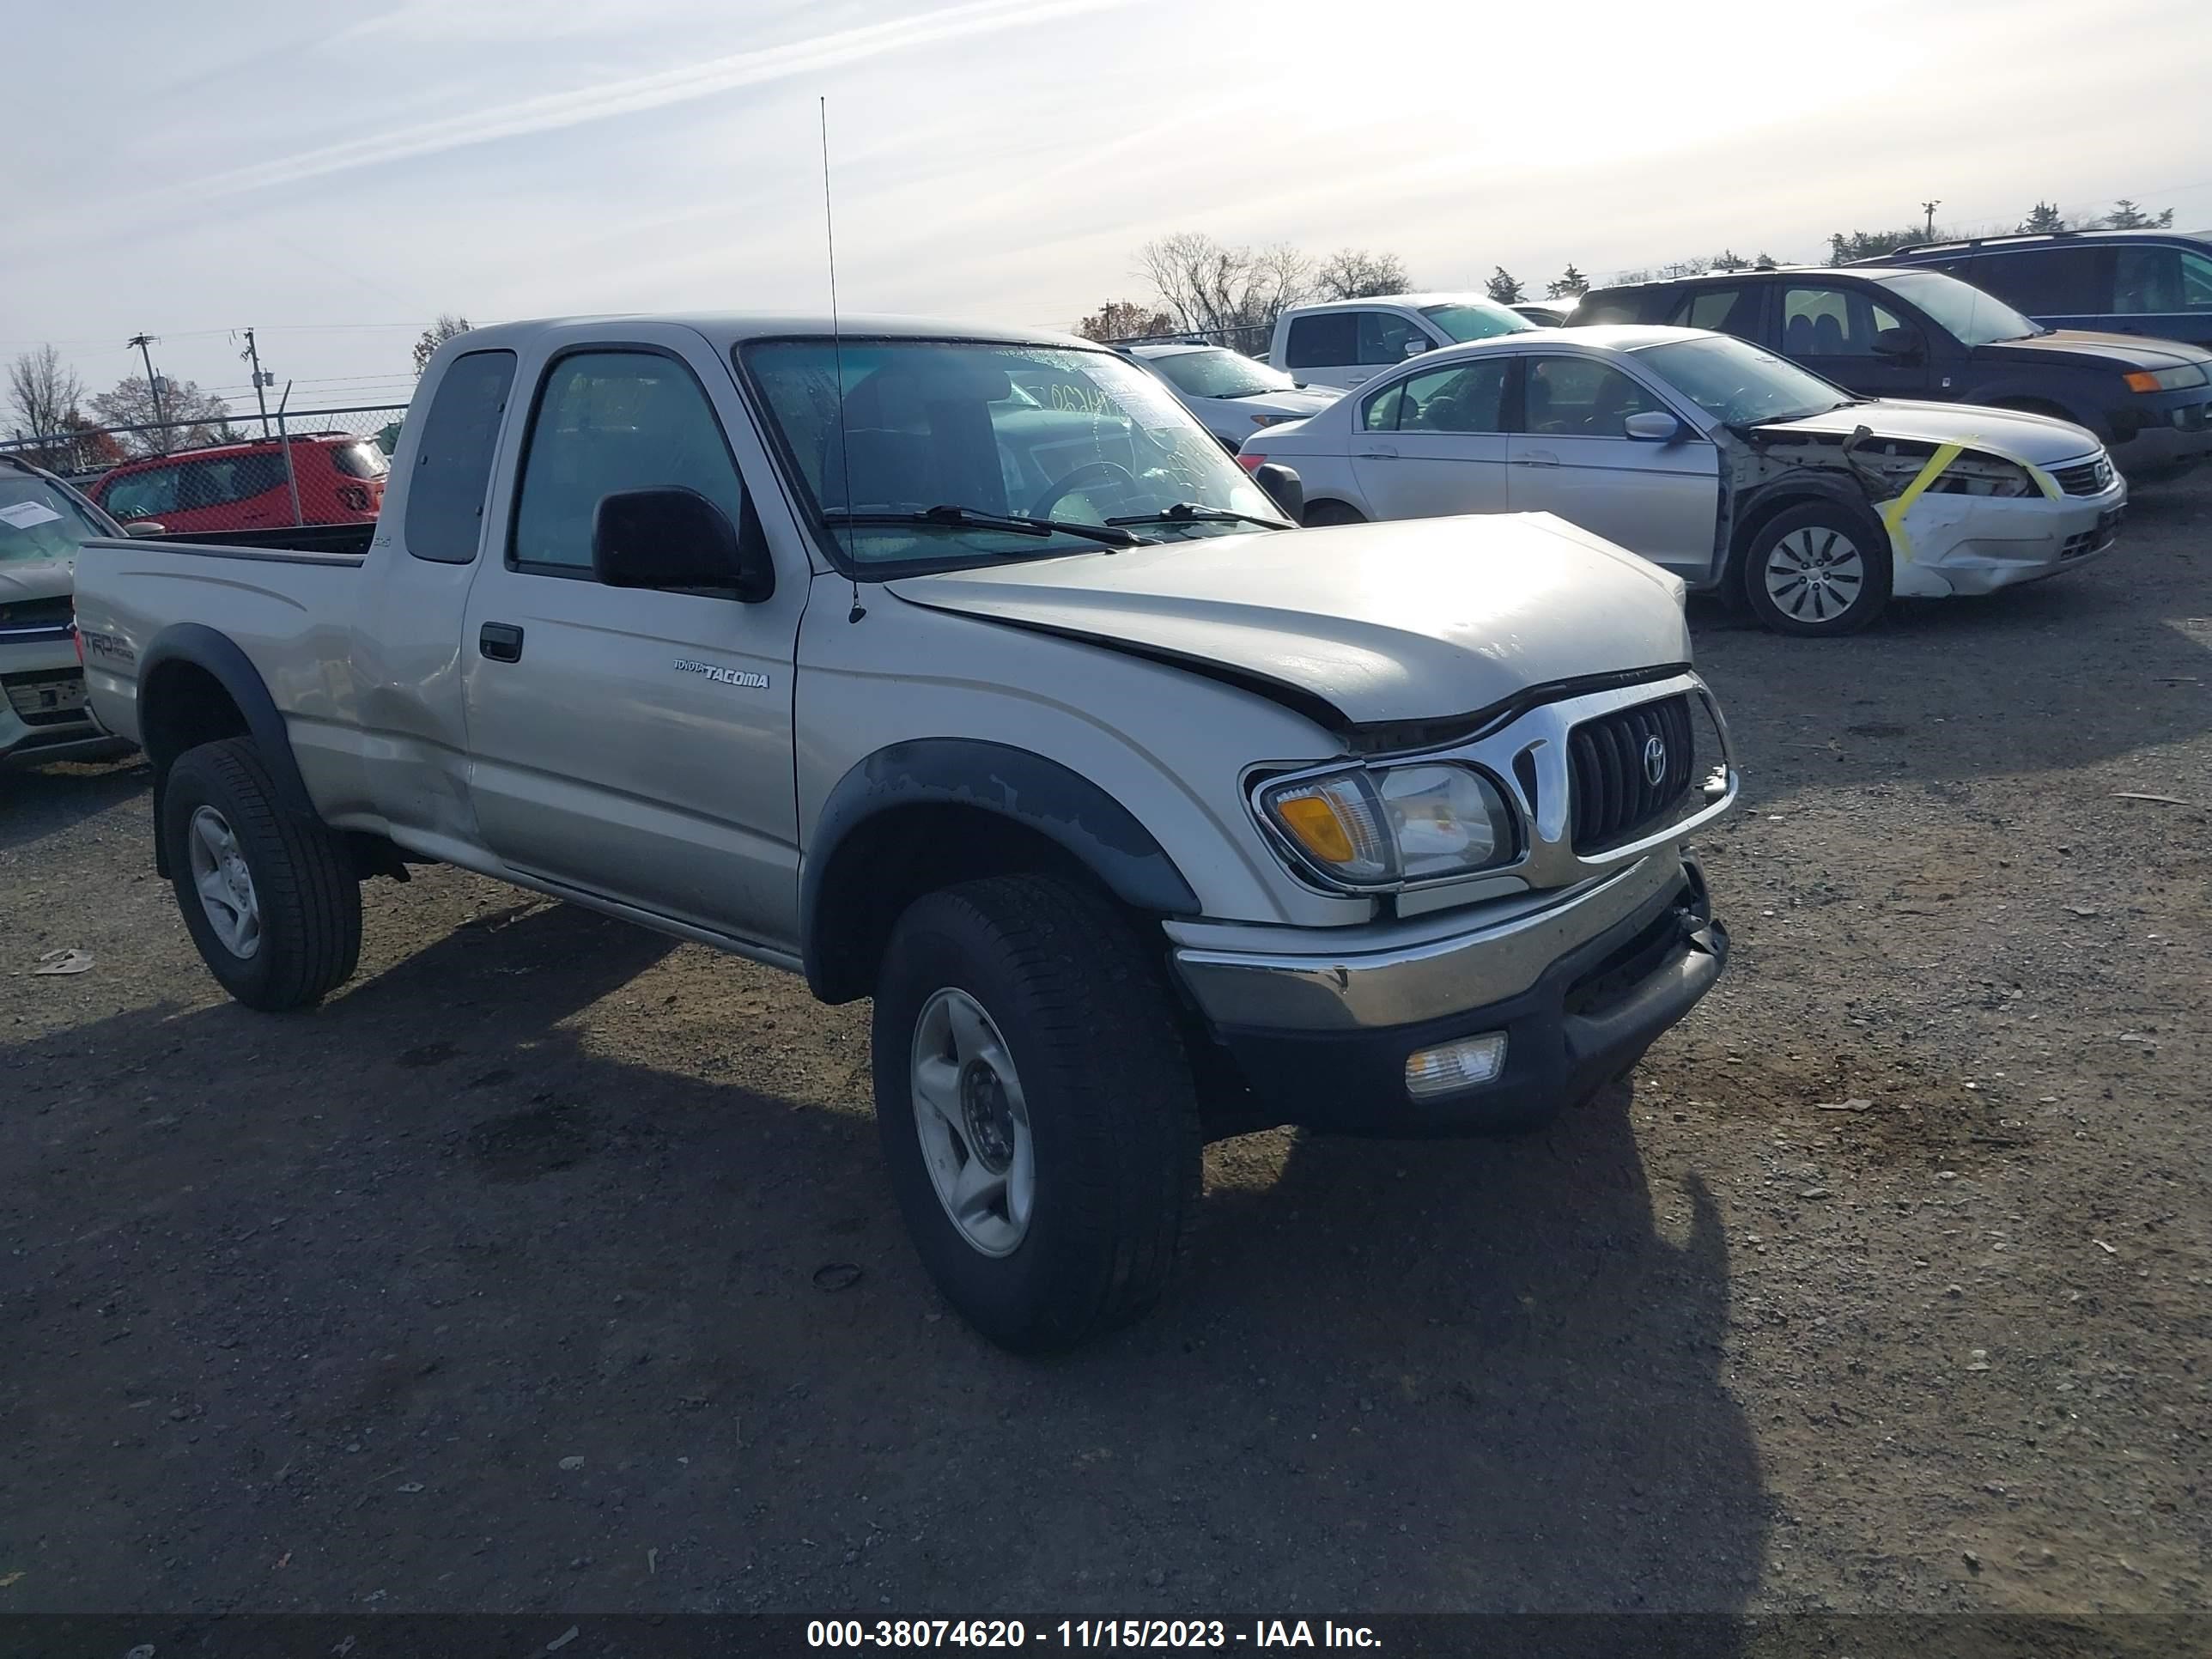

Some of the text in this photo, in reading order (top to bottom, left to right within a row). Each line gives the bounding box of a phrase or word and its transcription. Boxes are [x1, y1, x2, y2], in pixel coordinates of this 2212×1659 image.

[81, 630, 113, 656] TRD
[673, 659, 769, 689] TOYOTA TACOMA
